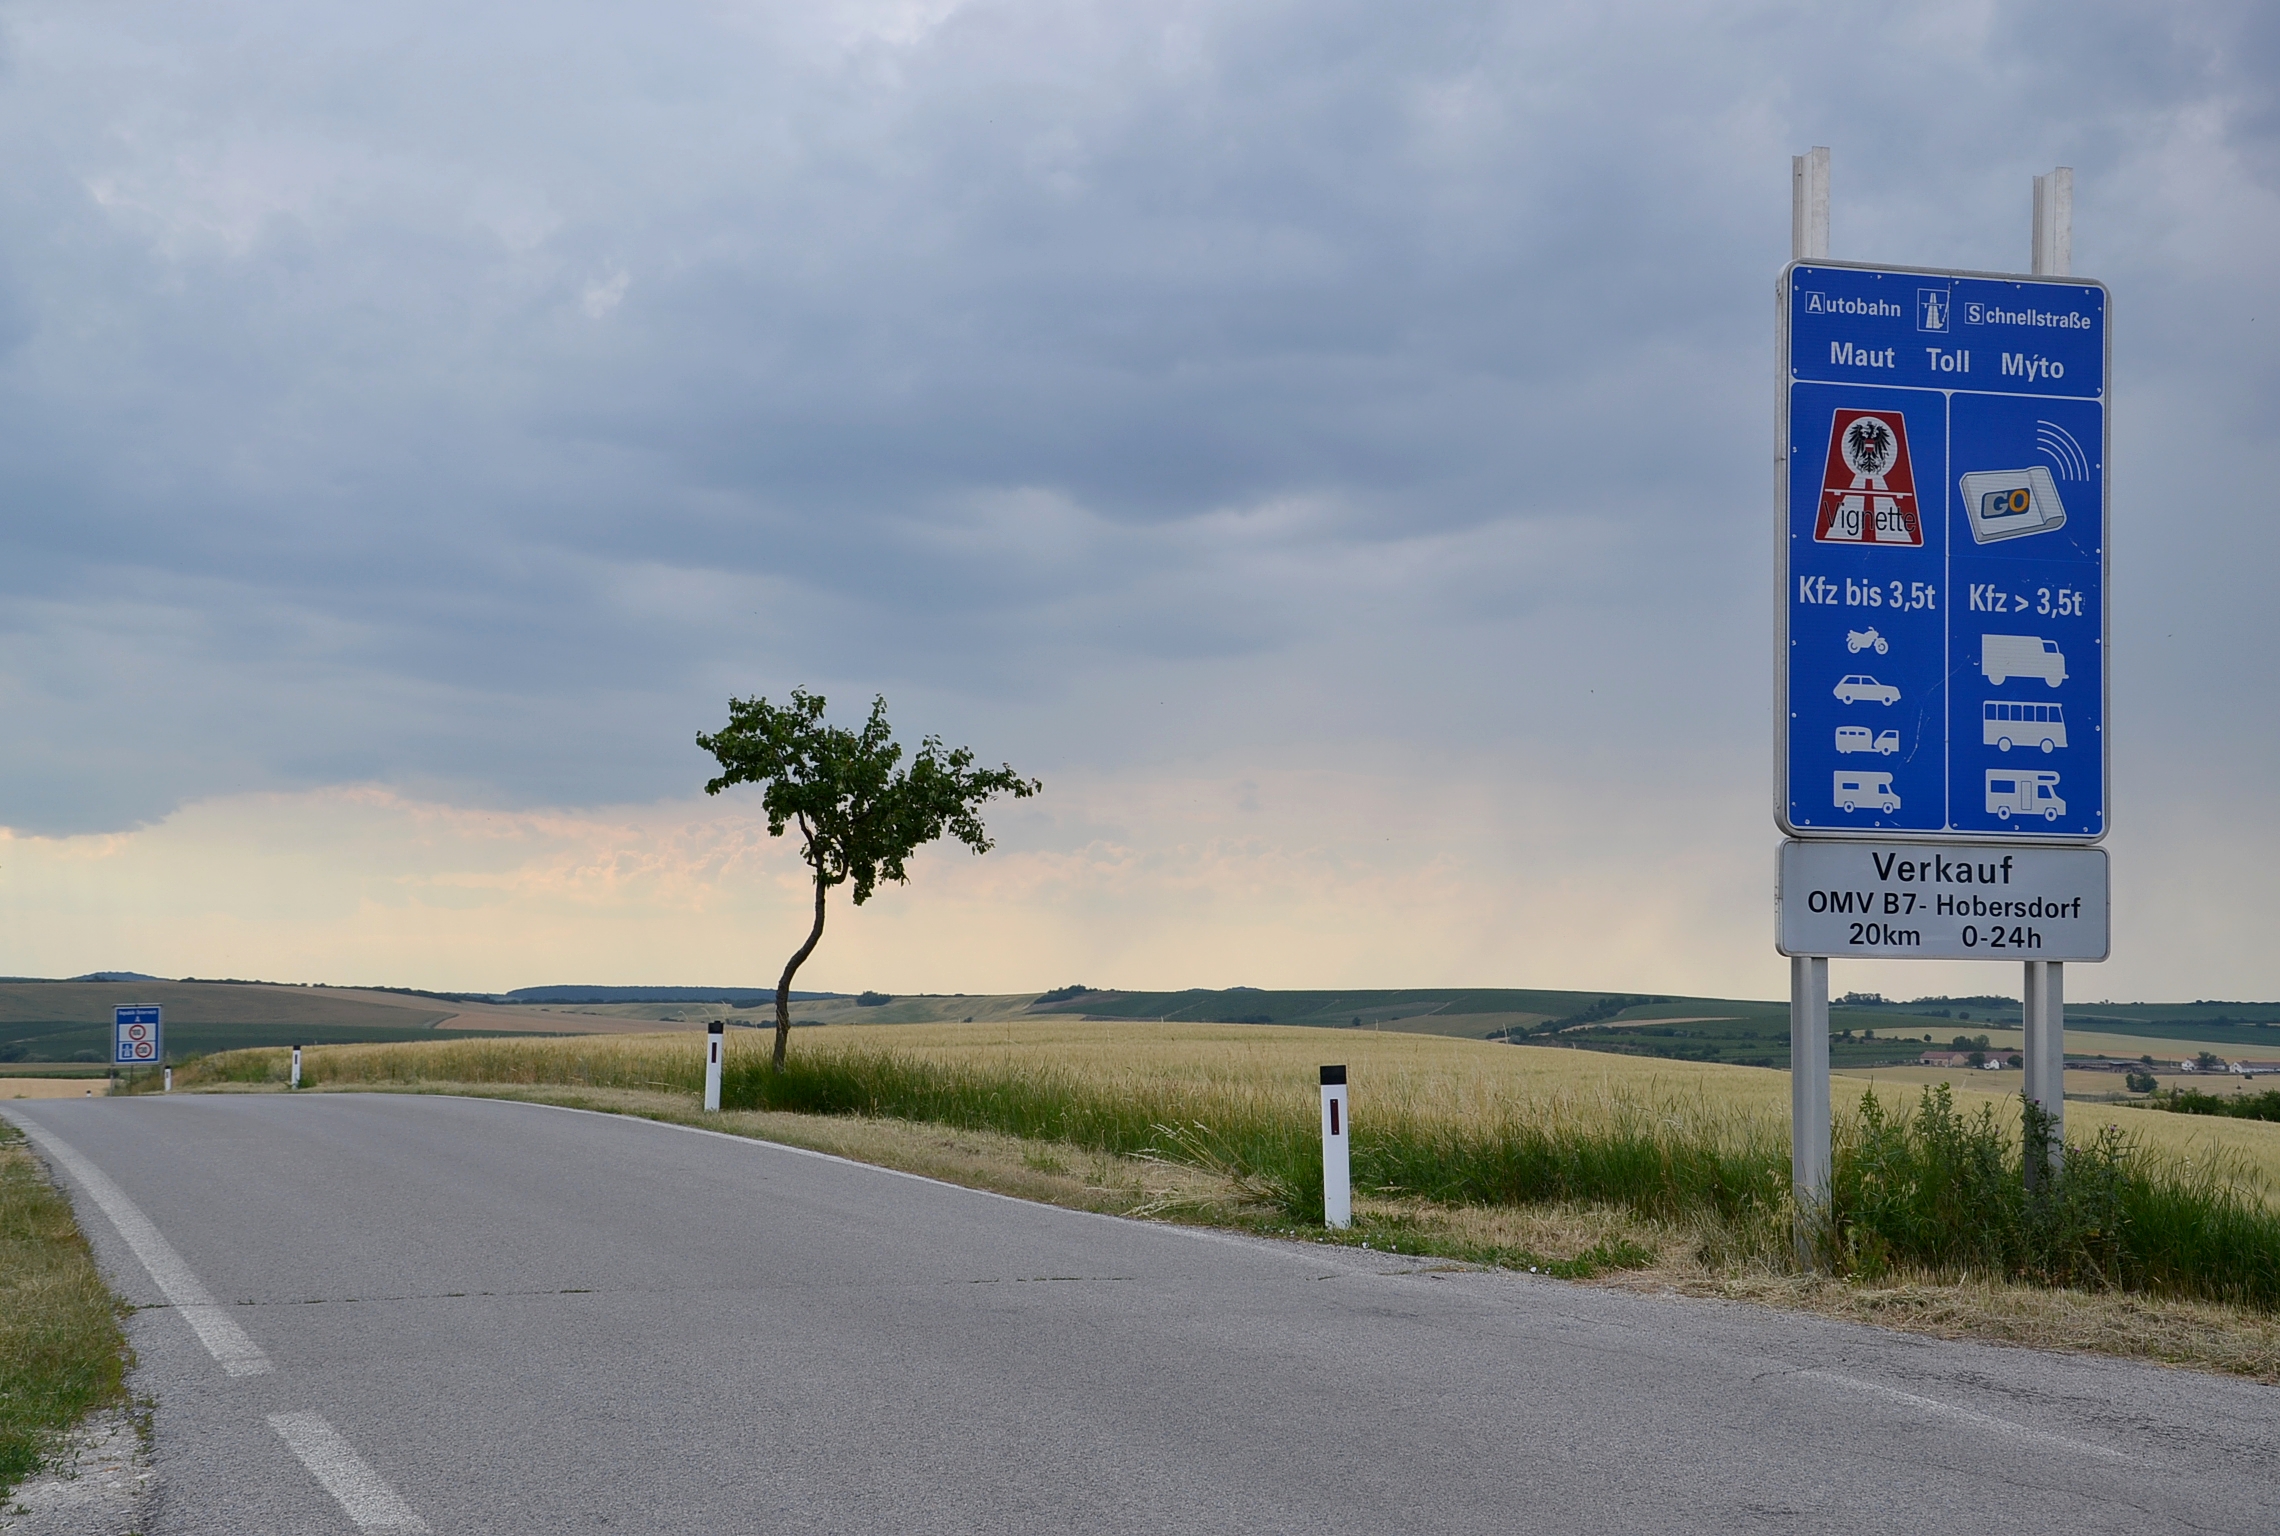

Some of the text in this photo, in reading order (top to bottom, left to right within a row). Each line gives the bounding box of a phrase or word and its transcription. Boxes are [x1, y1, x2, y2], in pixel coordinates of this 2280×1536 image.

[1805, 291, 1901, 317] Autobahn
[1965, 302, 2091, 330] Schnellstraße
[1830, 341, 2065, 382] Maut Toll Mýto
[1993, 489, 2030, 514] GO
[1824, 501, 1917, 536] Vignette
[1799, 576, 1936, 612] Kfz bis 3,5t
[1969, 583, 2007, 612] Kfz
[2036, 588, 2083, 619] 3,5t
[1872, 852, 2013, 884] Verkauf
[1807, 890, 1874, 914] OMV
[1937, 894, 2081, 919] Hobersdorf
[1849, 923, 1921, 946] 20km
[1962, 925, 2042, 949] 0-24h
